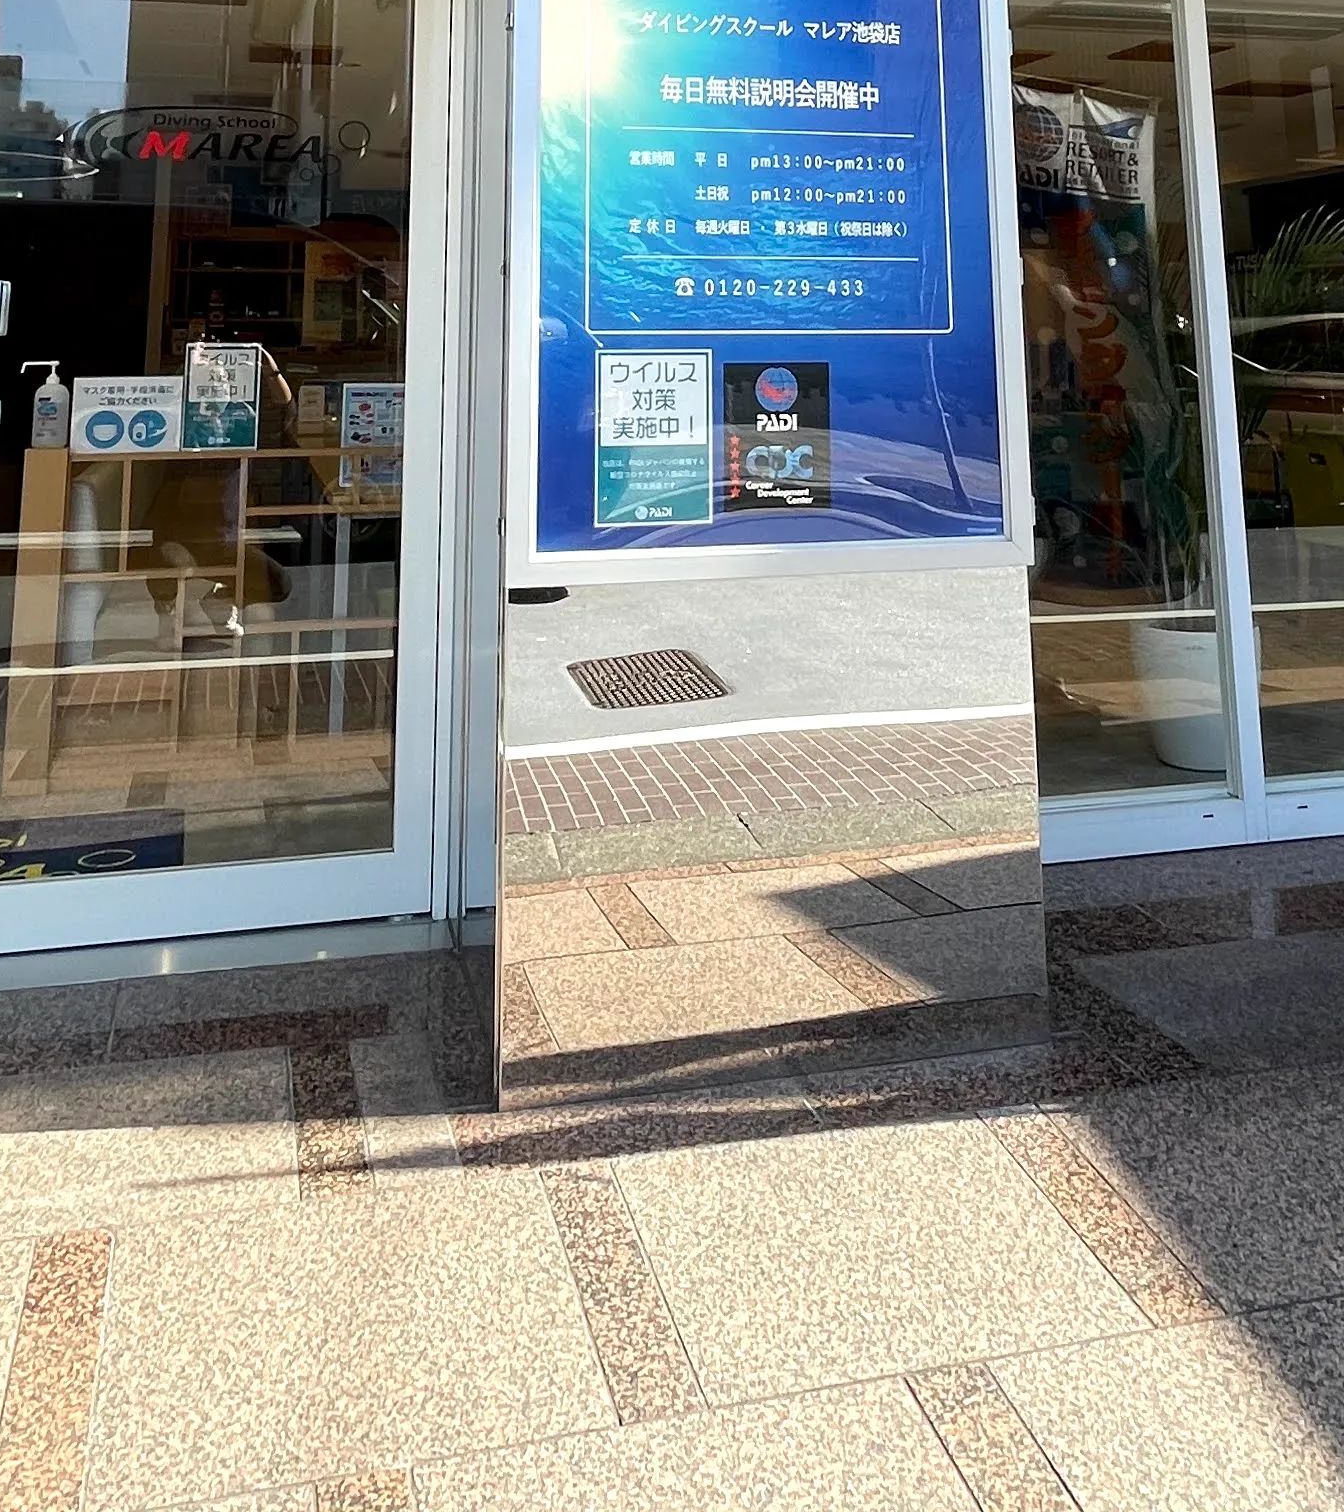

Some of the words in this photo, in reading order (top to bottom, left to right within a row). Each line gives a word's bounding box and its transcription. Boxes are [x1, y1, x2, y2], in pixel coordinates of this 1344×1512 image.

[637, 11, 794, 38] ダイビングスクール
[804, 21, 902, 46] マレア池袋店
[659, 74, 880, 112] 毎日無料説明会開催中
[154, 112, 212, 132] Diving
[218, 114, 276, 130] School
[138, 128, 323, 163] MAREA
[629, 150, 675, 168] 営業時間
[695, 152, 728, 168] 平日
[1019, 163, 1059, 189] ADI
[695, 185, 730, 201] 土日祝
[629, 218, 676, 235] 定休日
[704, 277, 865, 297] 0120-229-433
[609, 361, 698, 384] ウイルス
[631, 388, 677, 411] 対策
[756, 413, 798, 432] PADI
[745, 480, 774, 490] Career
[757, 488, 810, 499] Development
[786, 495, 814, 505] Center
[649, 506, 673, 518] PADI
